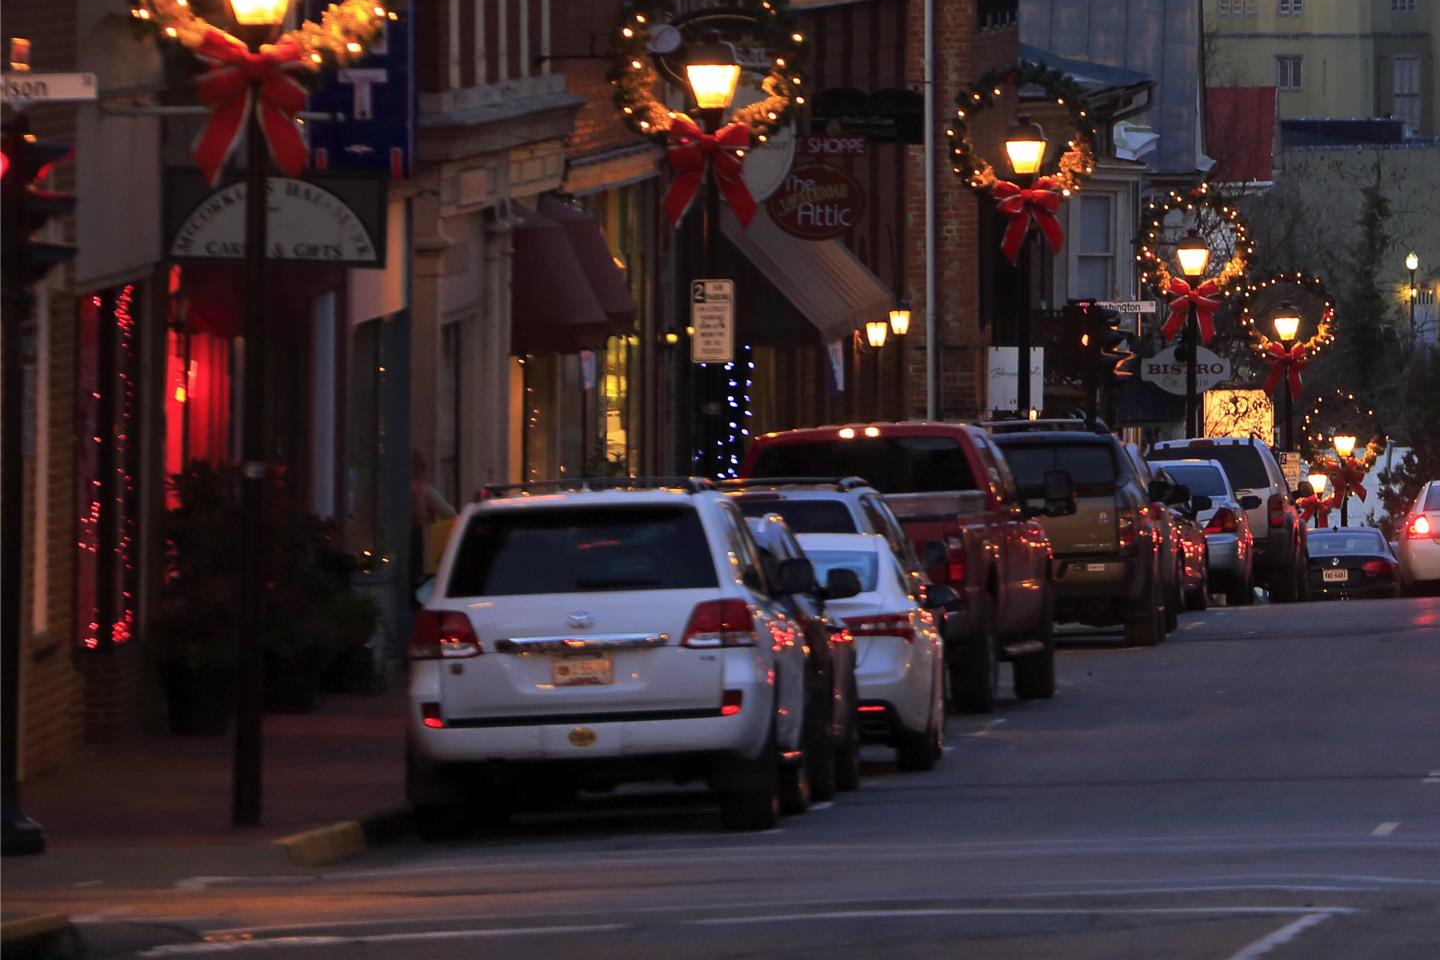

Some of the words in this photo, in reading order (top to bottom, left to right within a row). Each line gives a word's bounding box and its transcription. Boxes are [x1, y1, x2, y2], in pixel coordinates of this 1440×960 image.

[807, 138, 865, 155] SHOPPE
[786, 174, 817, 191] The
[796, 202, 853, 227] Attic
[292, 242, 342, 257] GIFTS
[694, 281, 705, 302] 2
[1101, 302, 1141, 313] ashington
